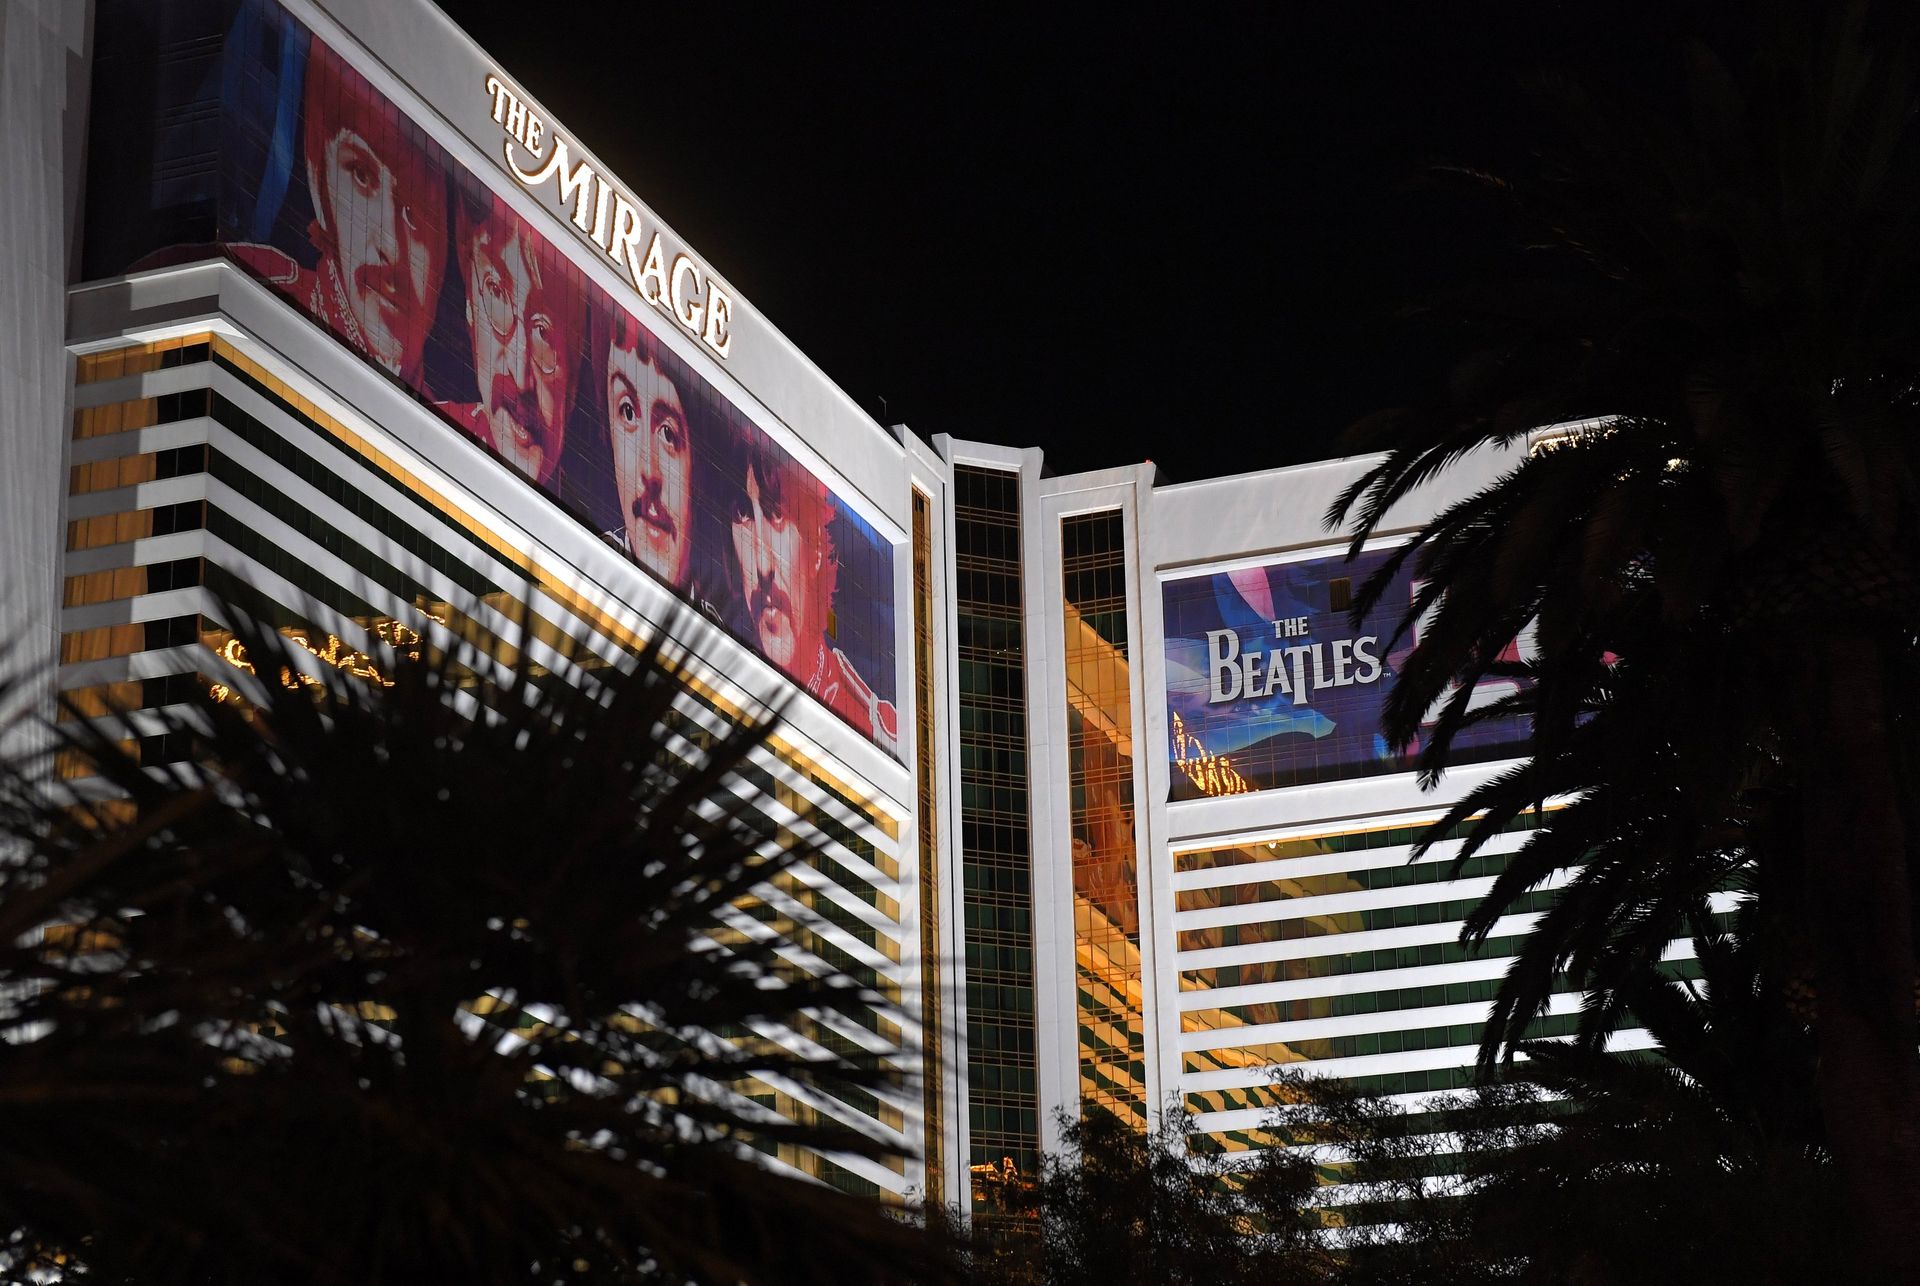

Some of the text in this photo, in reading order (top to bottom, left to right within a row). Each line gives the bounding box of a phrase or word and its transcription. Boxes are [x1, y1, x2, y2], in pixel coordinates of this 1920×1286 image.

[486, 76, 733, 360] THE MIRAGE
[1271, 616, 1309, 639] THE
[1205, 628, 1382, 705] BEATLES
